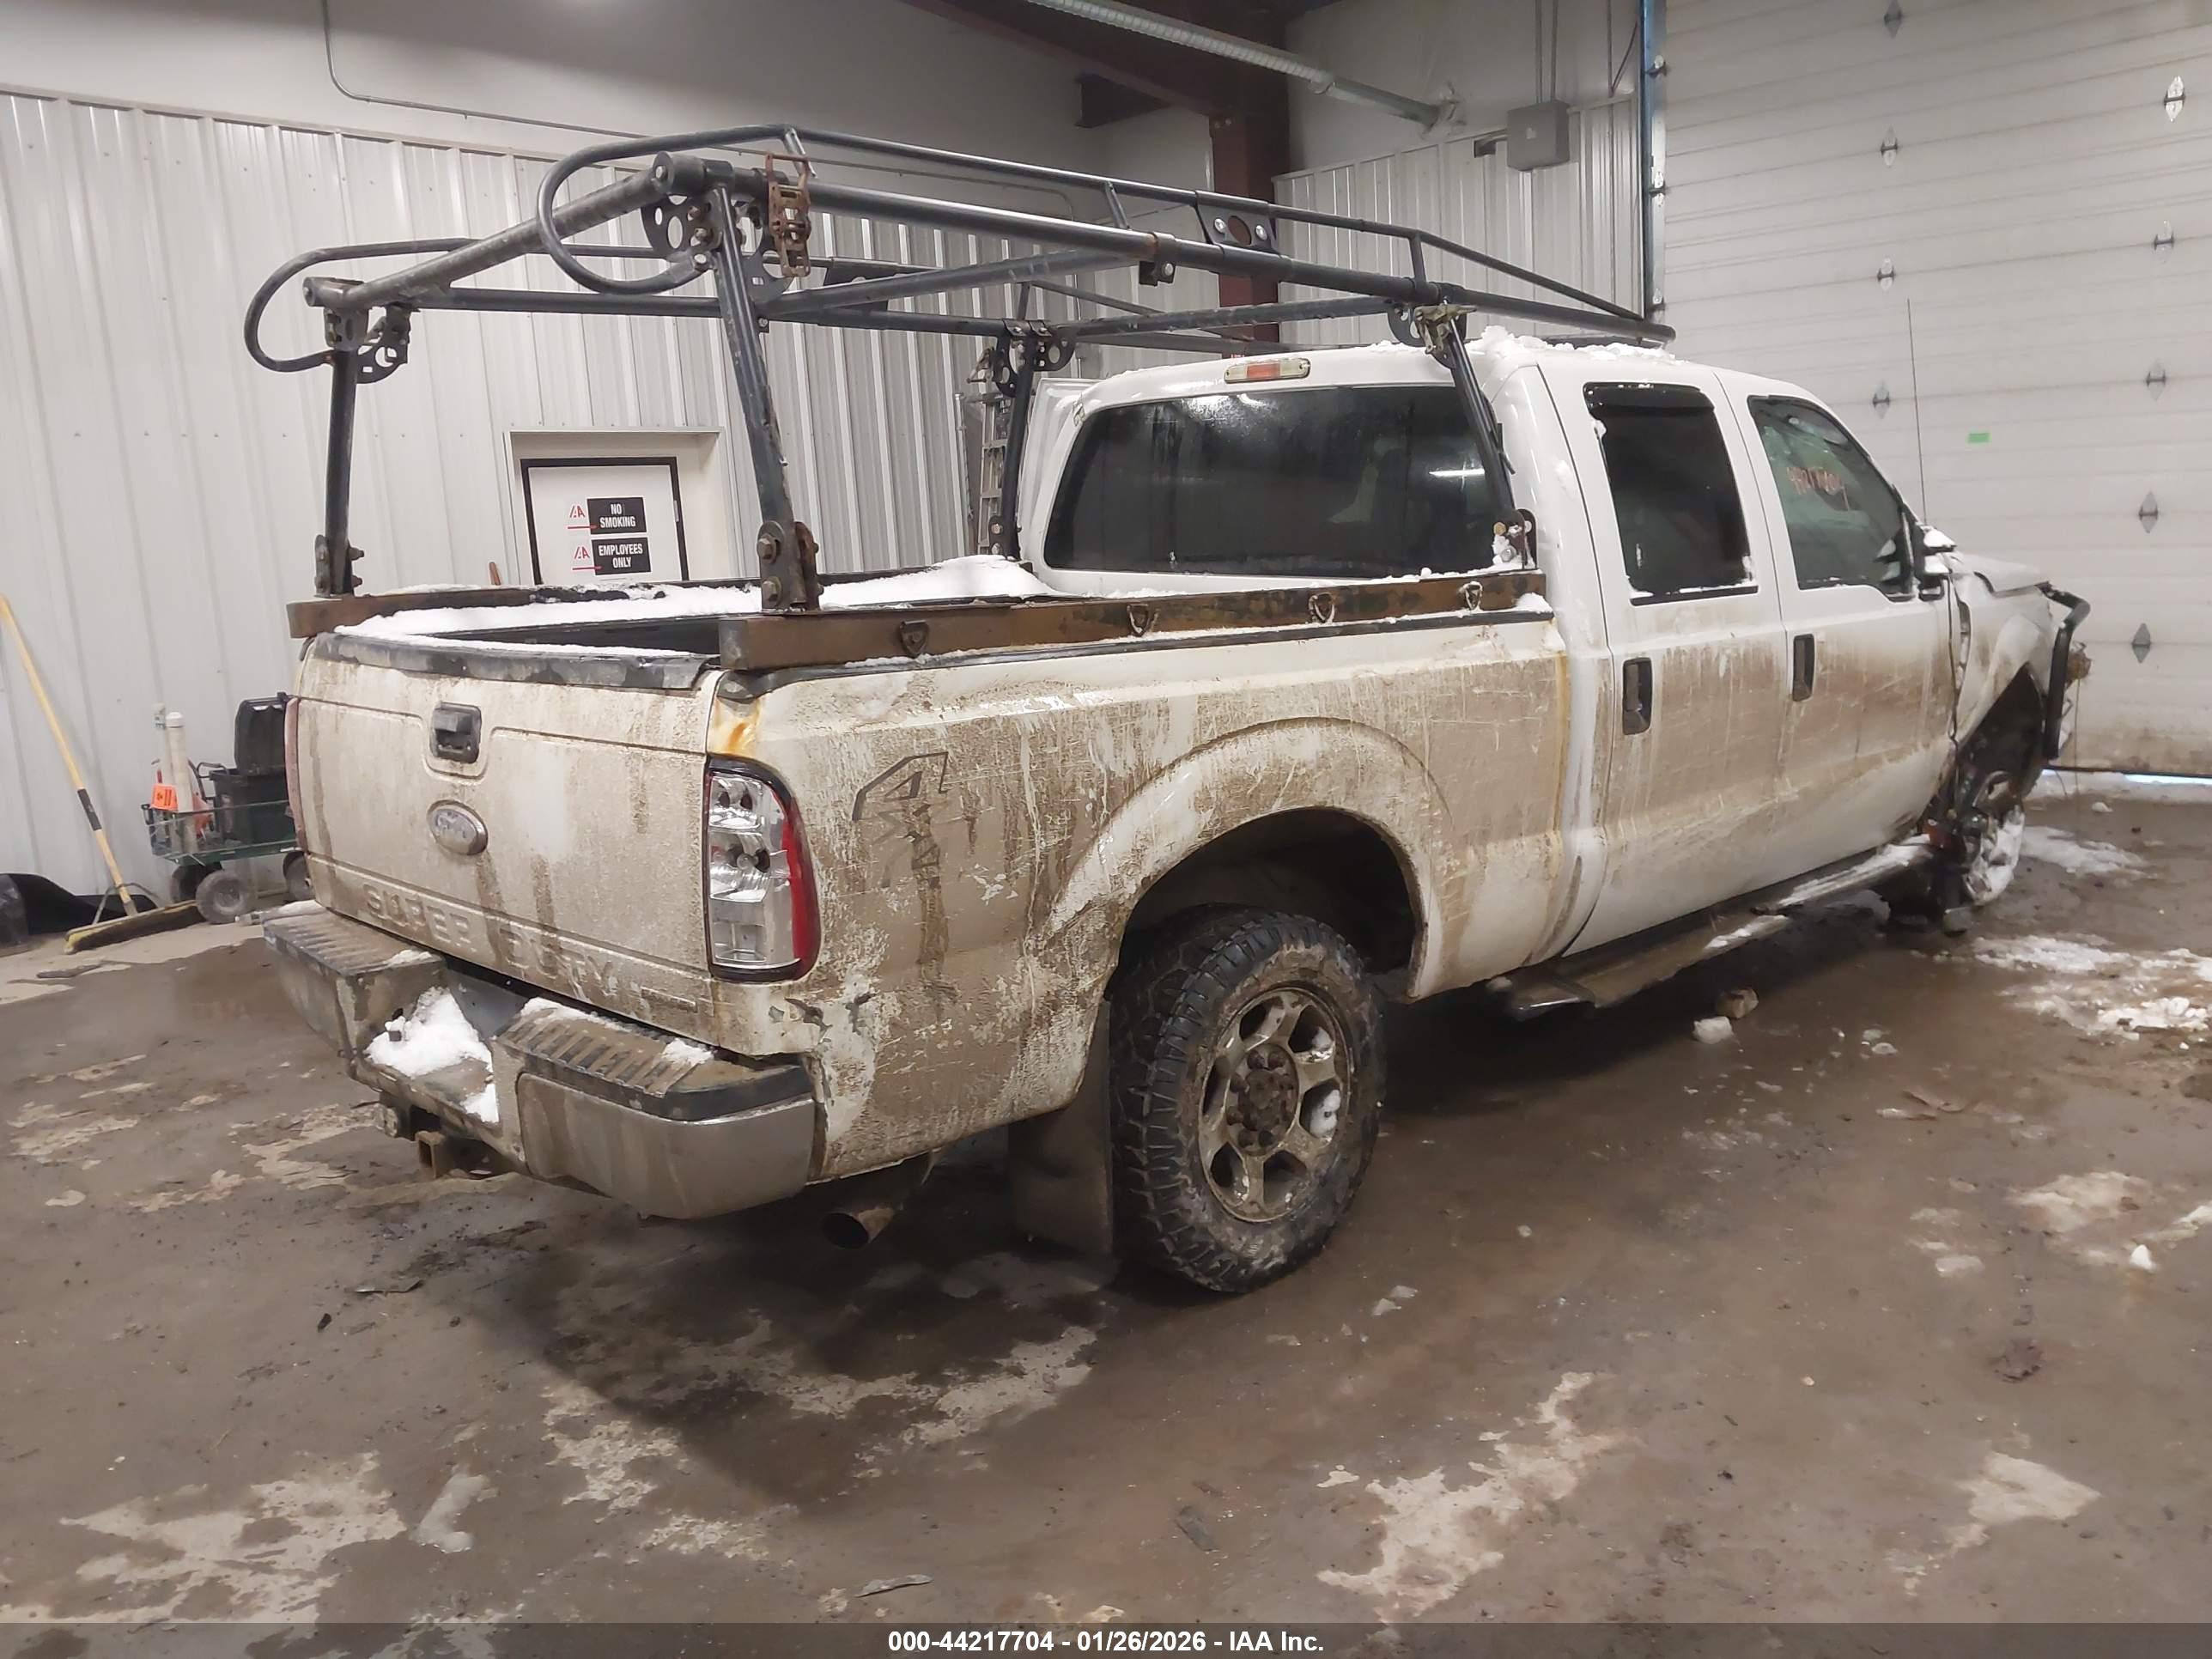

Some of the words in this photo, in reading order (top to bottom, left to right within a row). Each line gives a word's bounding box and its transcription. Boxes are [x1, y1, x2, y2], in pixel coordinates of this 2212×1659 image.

[611, 503, 623, 514] NO
[599, 516, 636, 528] SMOKING
[598, 543, 643, 556] EMPLOYEES
[612, 557, 633, 568] ONLY
